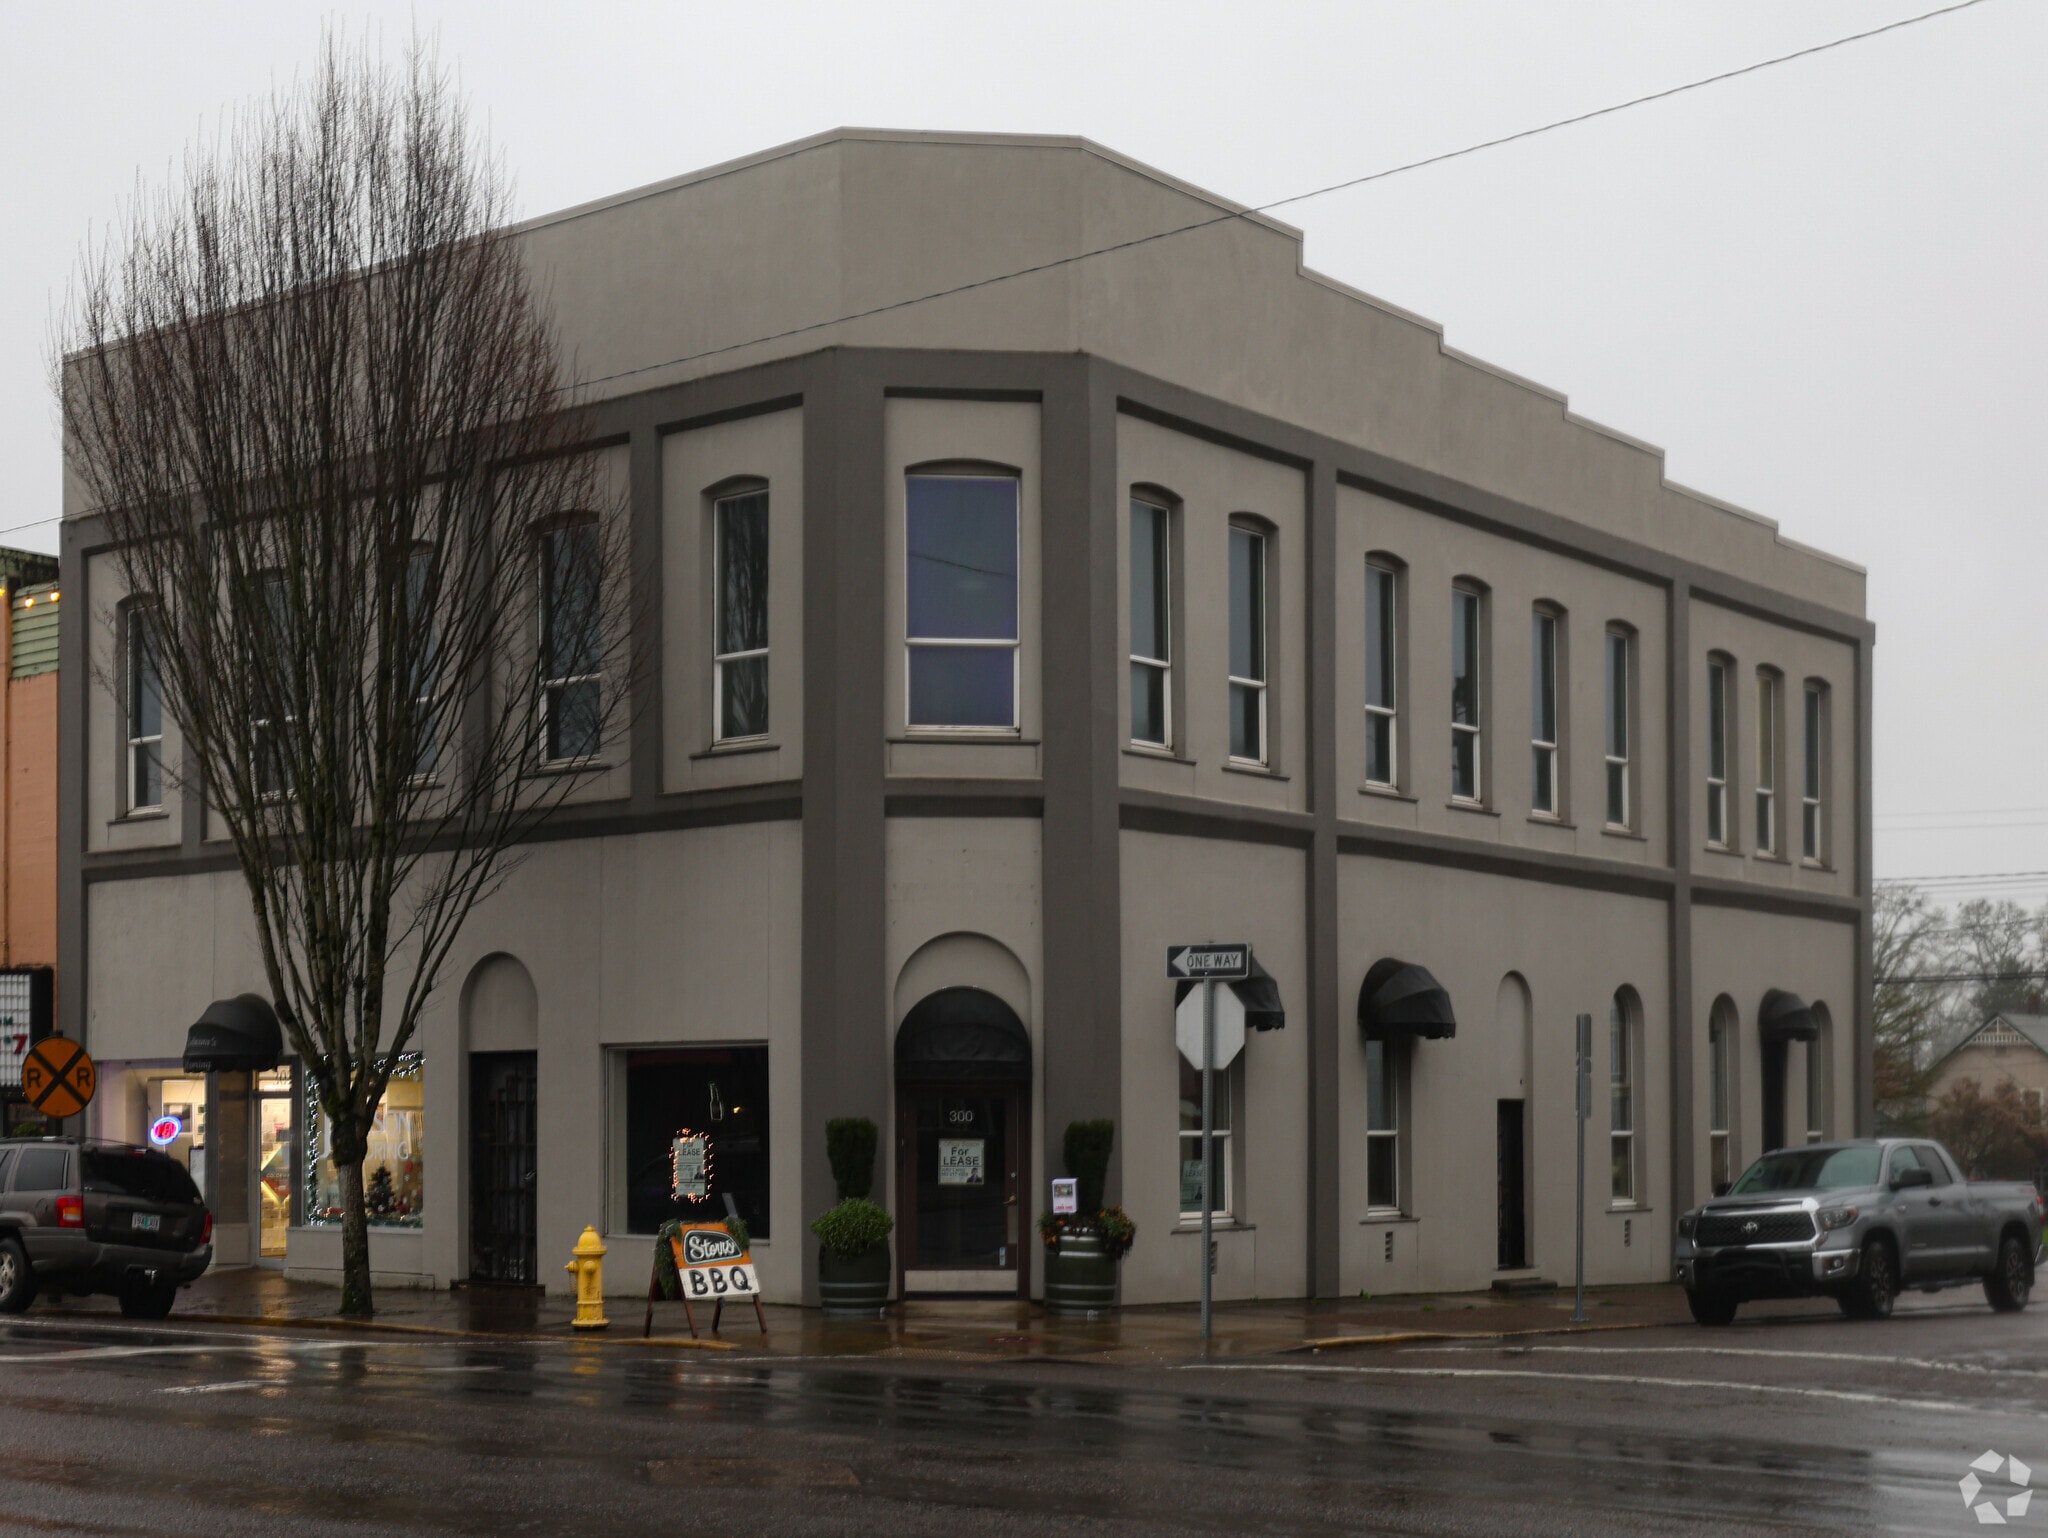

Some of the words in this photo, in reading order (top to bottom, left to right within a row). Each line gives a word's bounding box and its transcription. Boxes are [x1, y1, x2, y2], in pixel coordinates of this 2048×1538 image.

[1186, 954, 1210, 968] ONE
[1213, 954, 1239, 967] WAY
[949, 1110, 973, 1122] 300
[951, 1146, 969, 1156] For
[943, 1156, 979, 1166] LEASE
[689, 1266, 752, 1296] BBQ
